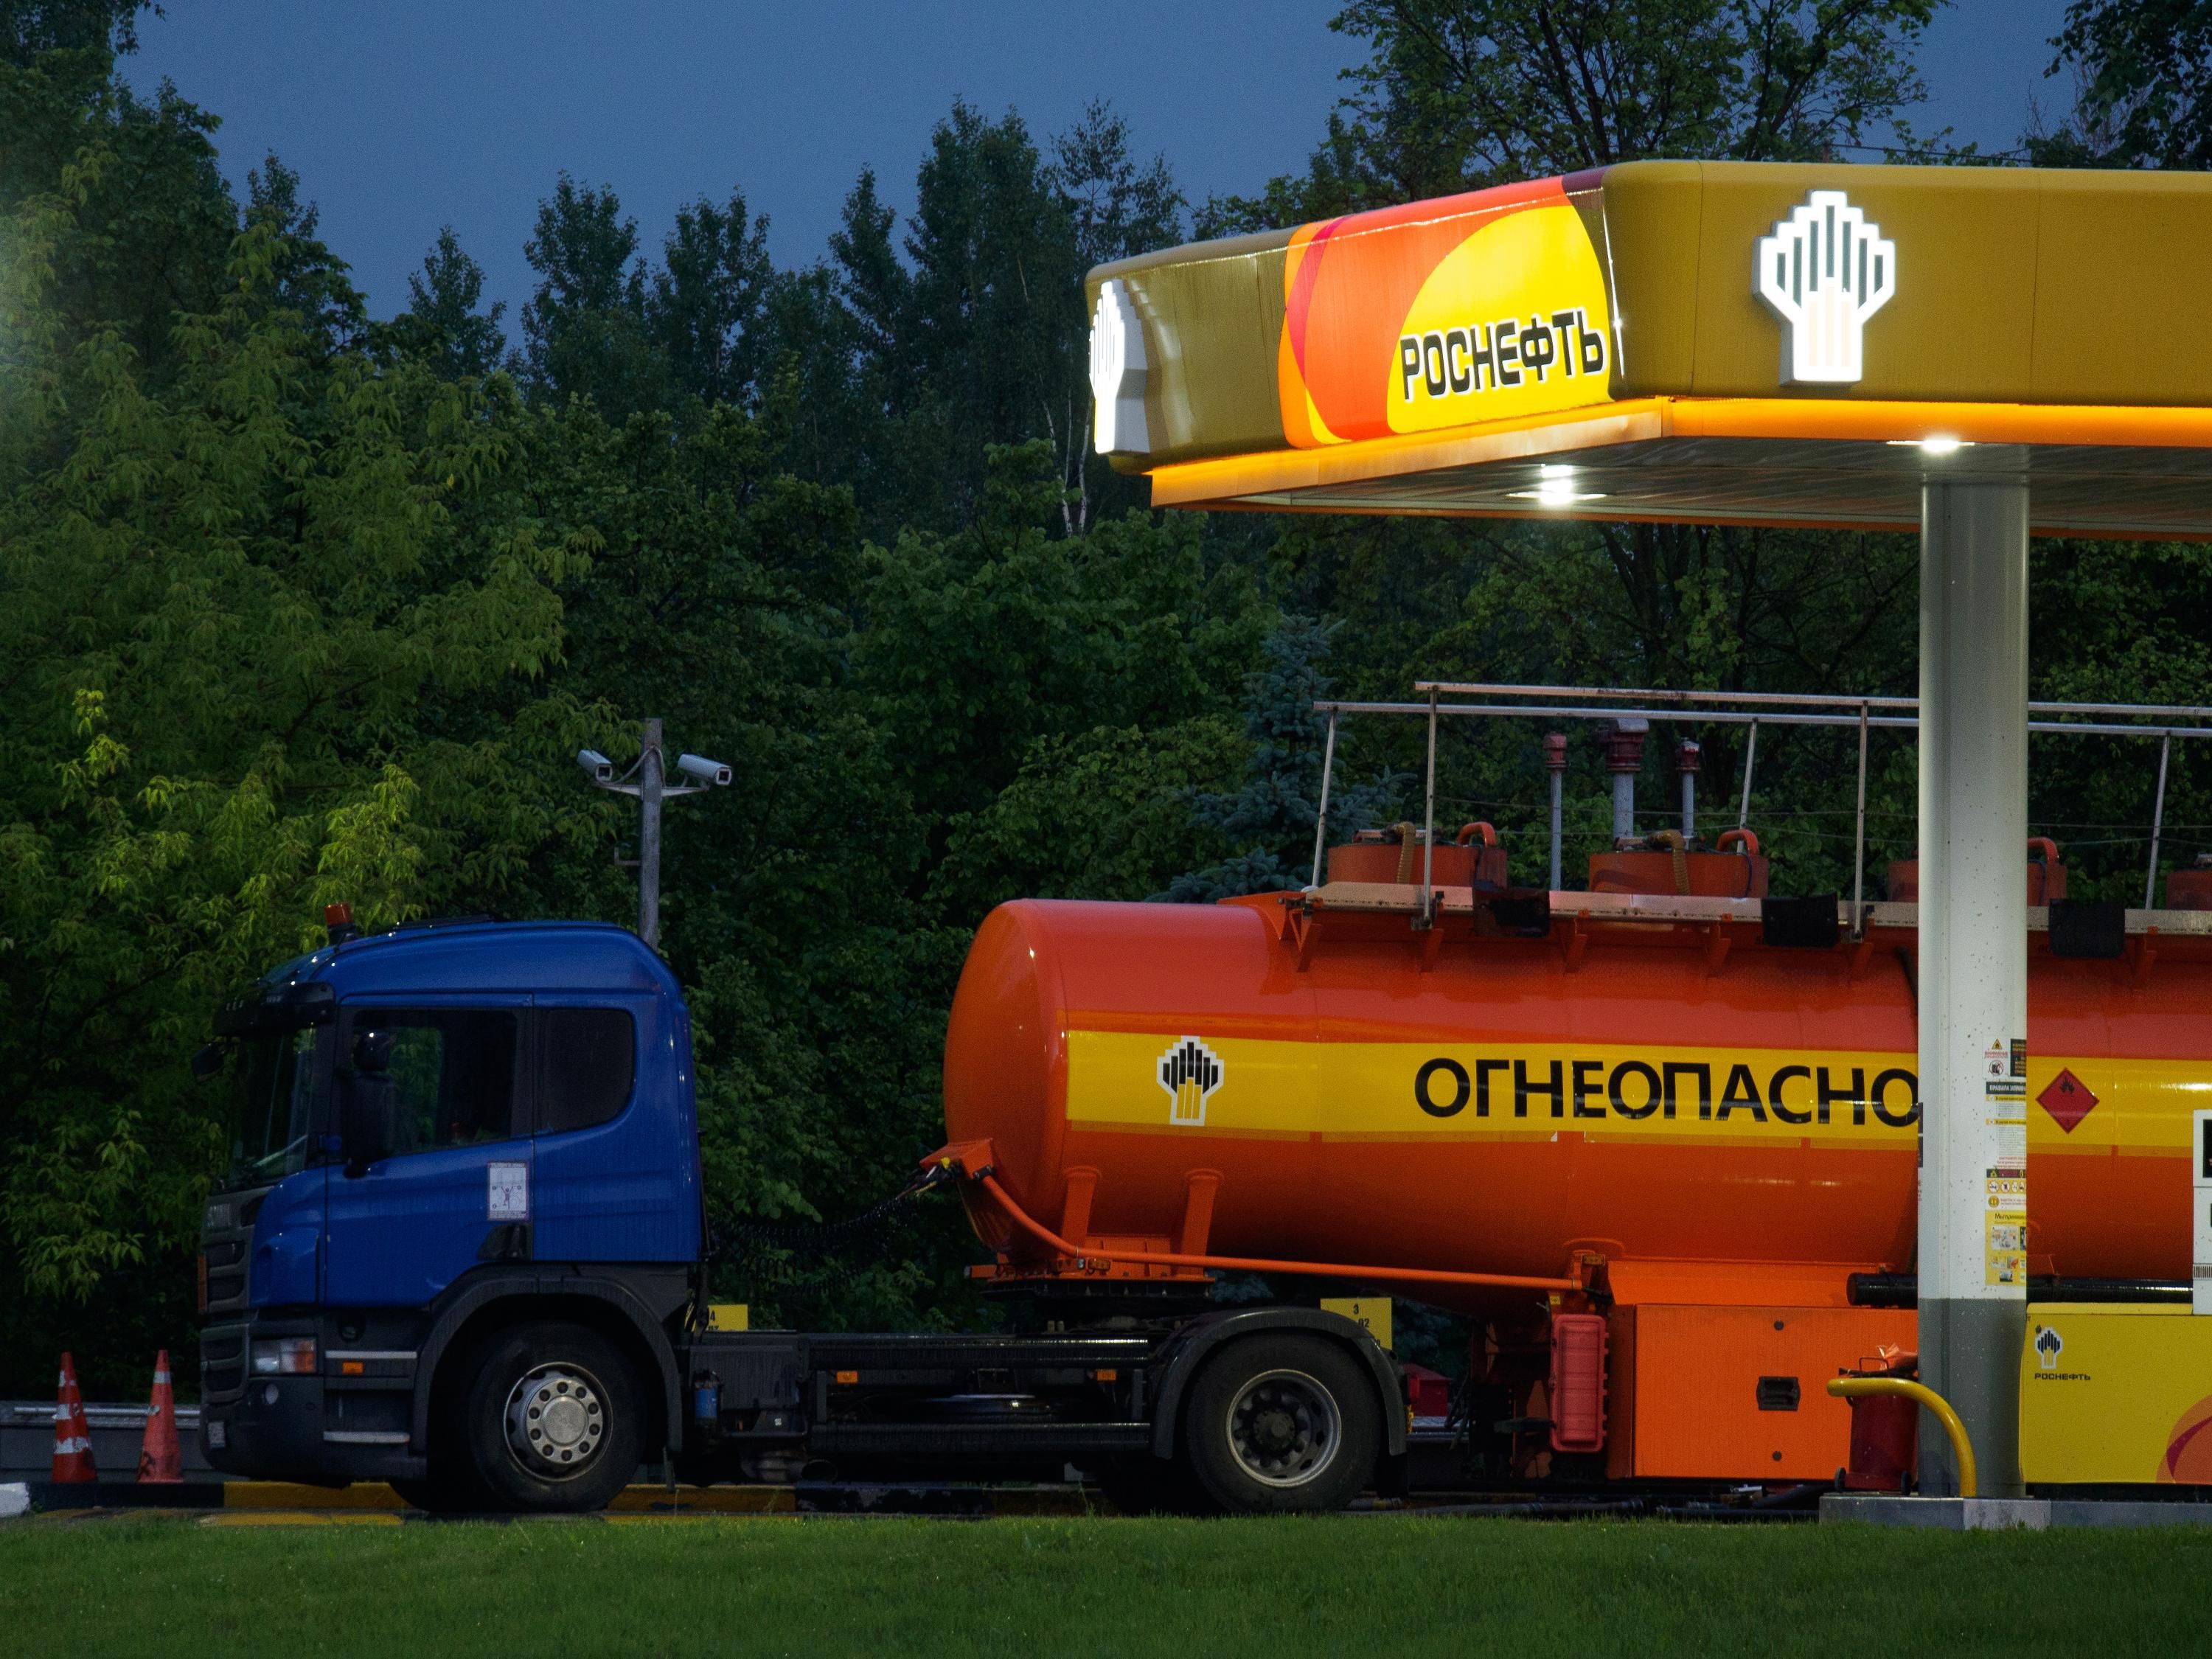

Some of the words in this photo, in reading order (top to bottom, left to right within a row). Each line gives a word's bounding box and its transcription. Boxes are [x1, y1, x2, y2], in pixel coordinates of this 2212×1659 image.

[1400, 310, 1604, 400] РОСНЕФТЬ
[1414, 1057, 1918, 1127] ОГНЕОПАСНО
[2034, 1373, 2091, 1381] РОСНЕФТЬ
